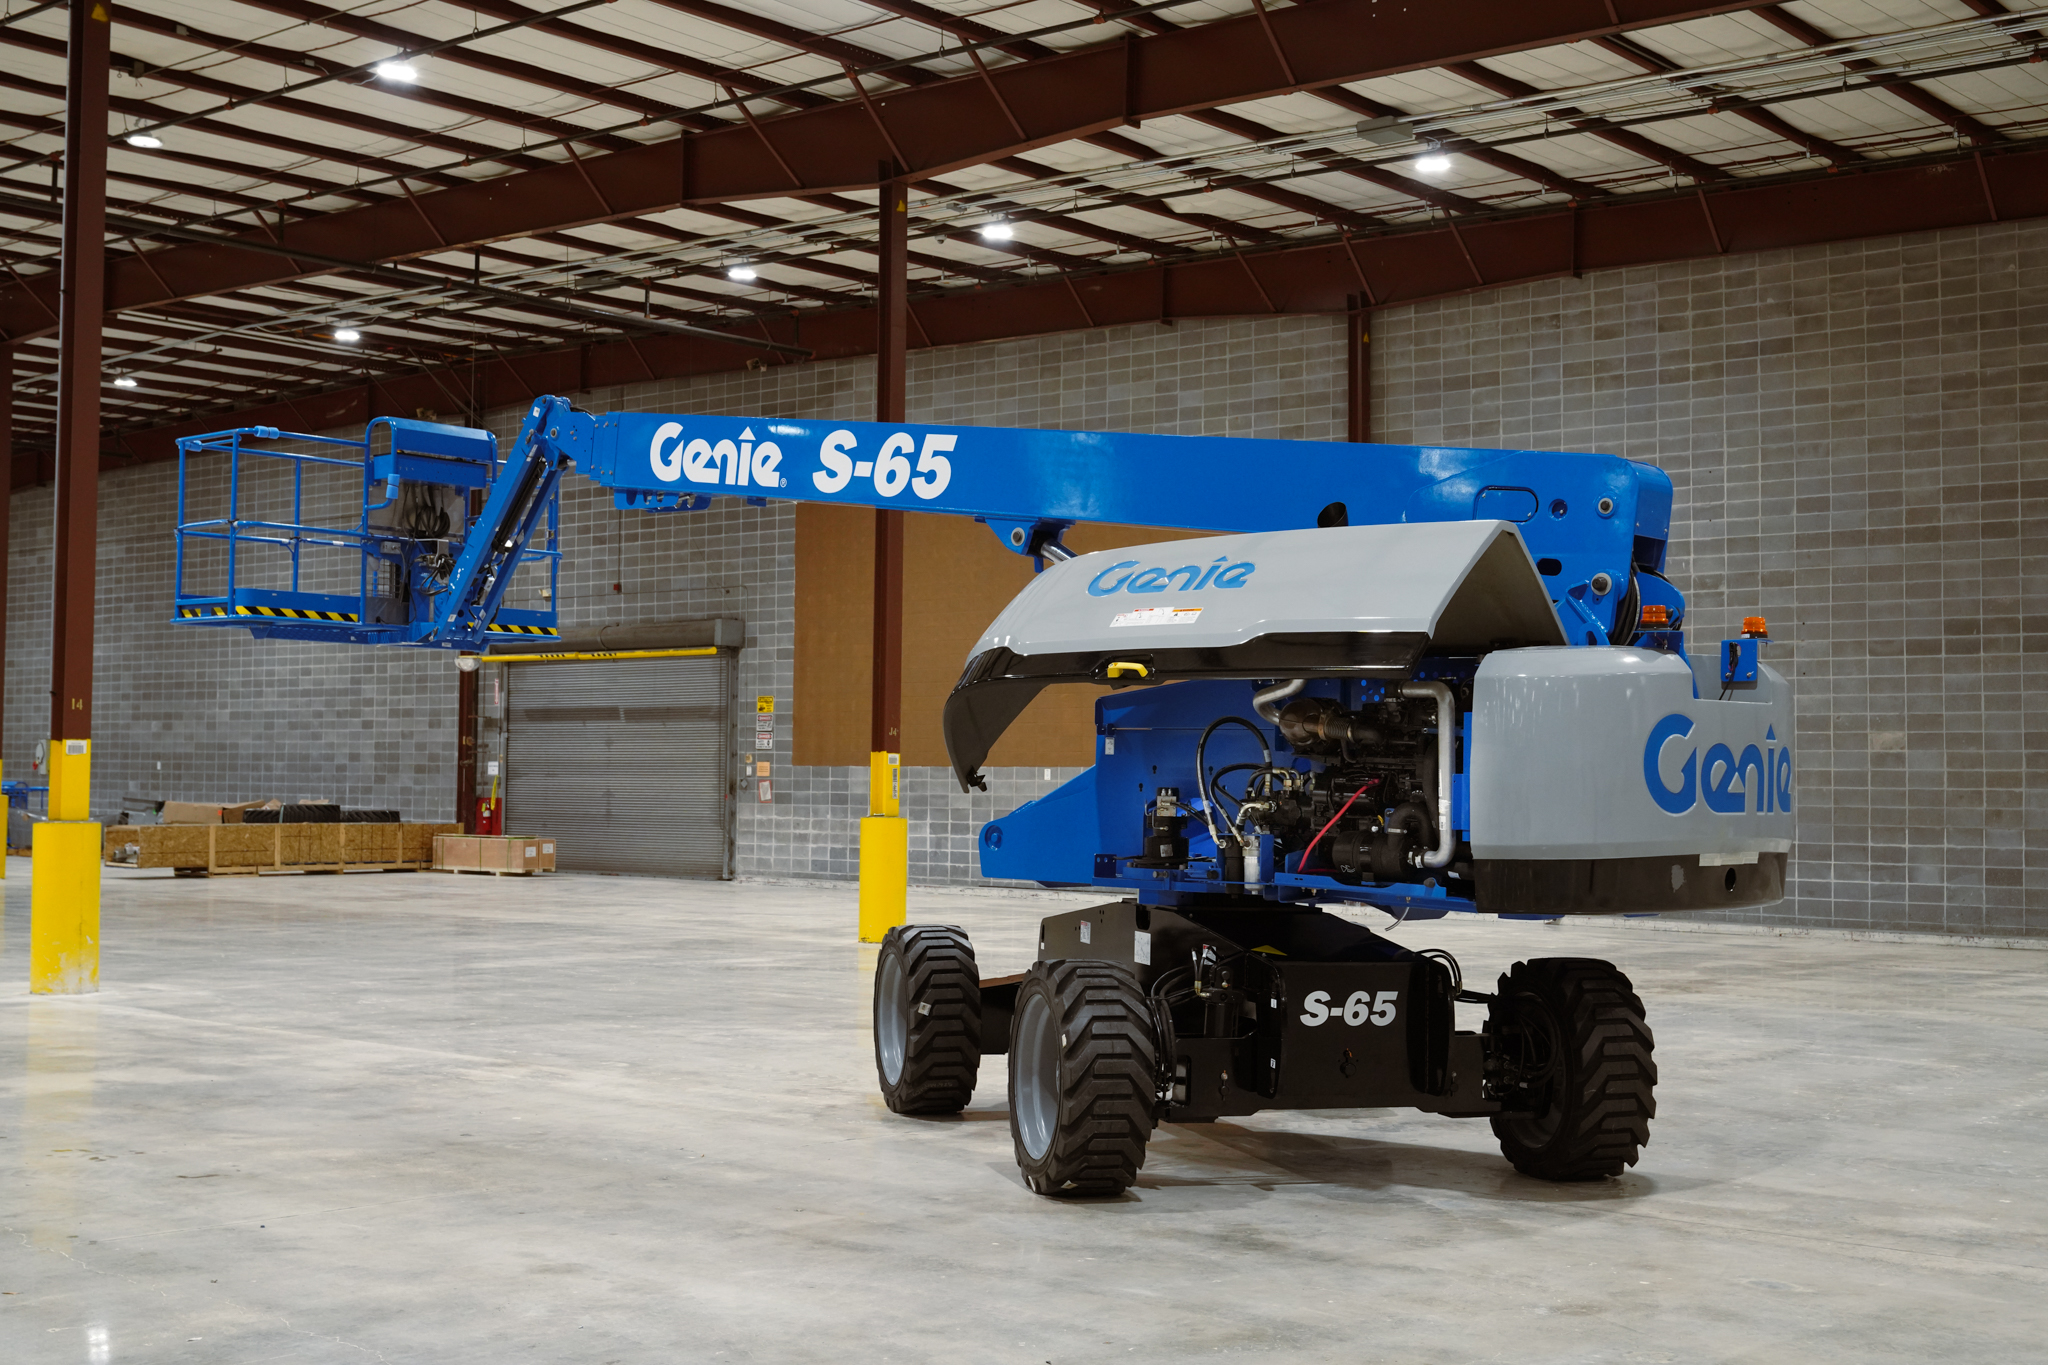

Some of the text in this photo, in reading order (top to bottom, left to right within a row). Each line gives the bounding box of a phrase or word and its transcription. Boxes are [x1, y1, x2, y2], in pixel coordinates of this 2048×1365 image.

[812, 429, 958, 500] S-65
[1087, 555, 1256, 597] Genie
[1643, 713, 1792, 816] Genie
[1299, 990, 1399, 1027] S-65
